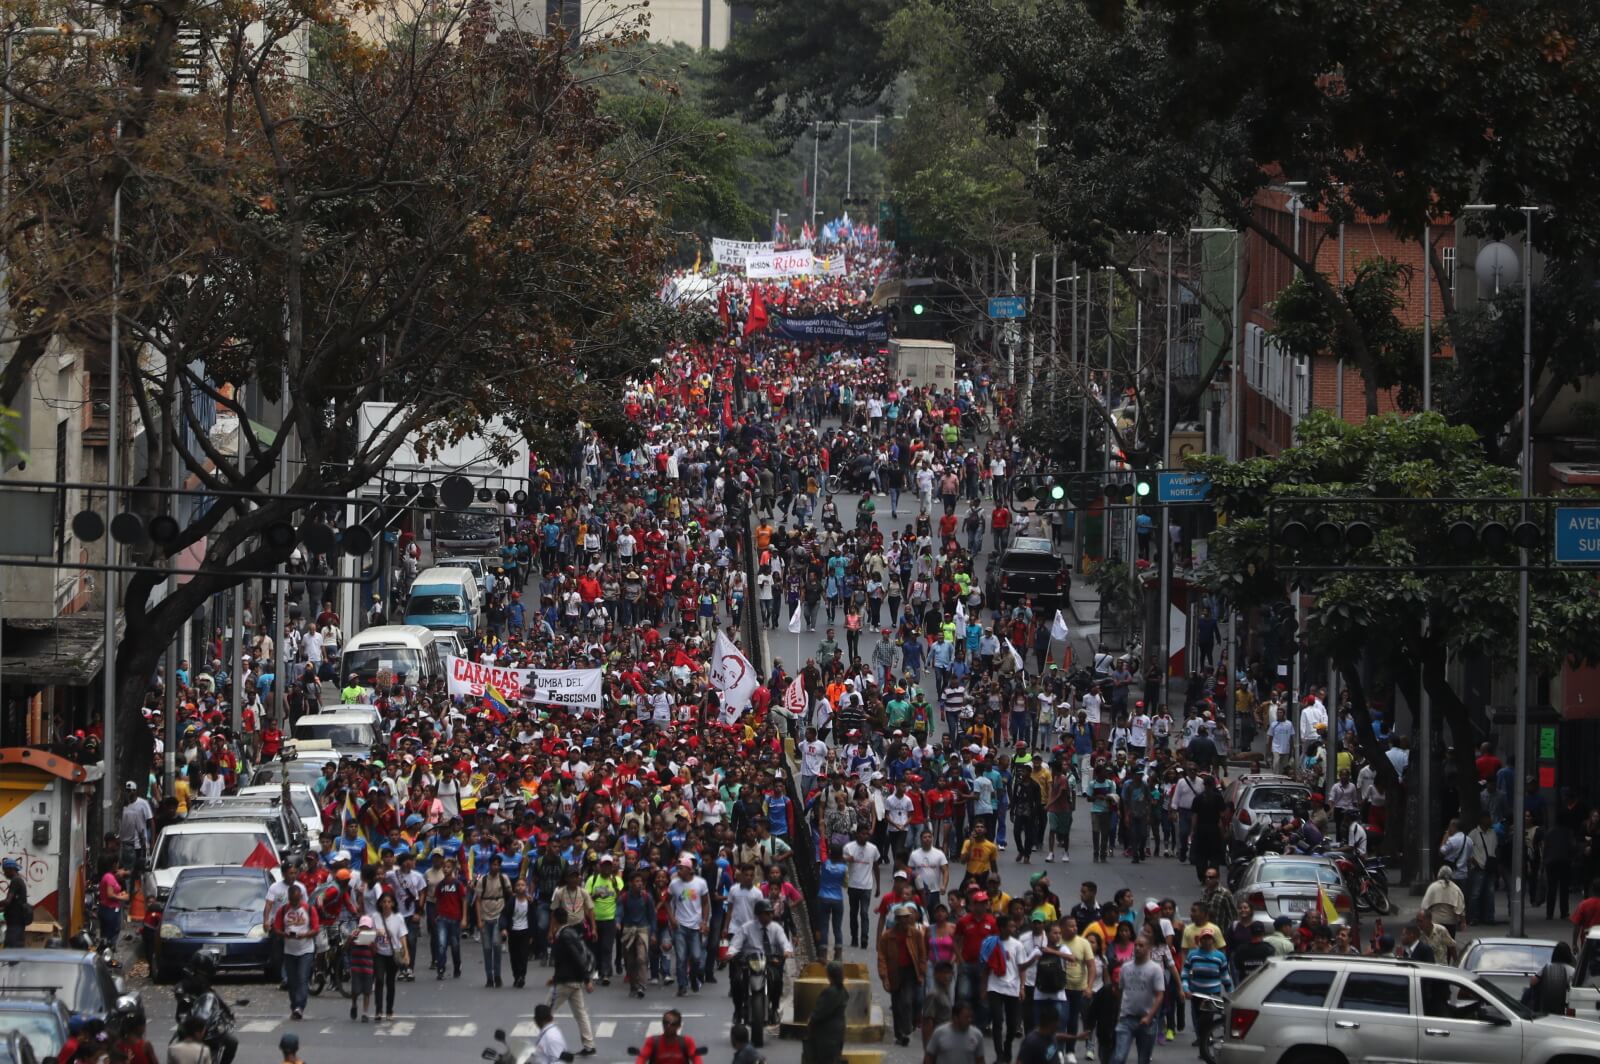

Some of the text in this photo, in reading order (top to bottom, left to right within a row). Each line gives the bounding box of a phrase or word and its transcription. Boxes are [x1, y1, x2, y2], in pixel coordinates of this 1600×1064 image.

[726, 248, 739, 256] DE
[773, 256, 810, 271] Ribas
[814, 326, 824, 334] LOS
[825, 327, 843, 335] VALLES
[844, 328, 854, 336] DEL
[1170, 488, 1193, 497] NORTE
[454, 658, 519, 690] CARACAS
[566, 678, 584, 688] DEL
